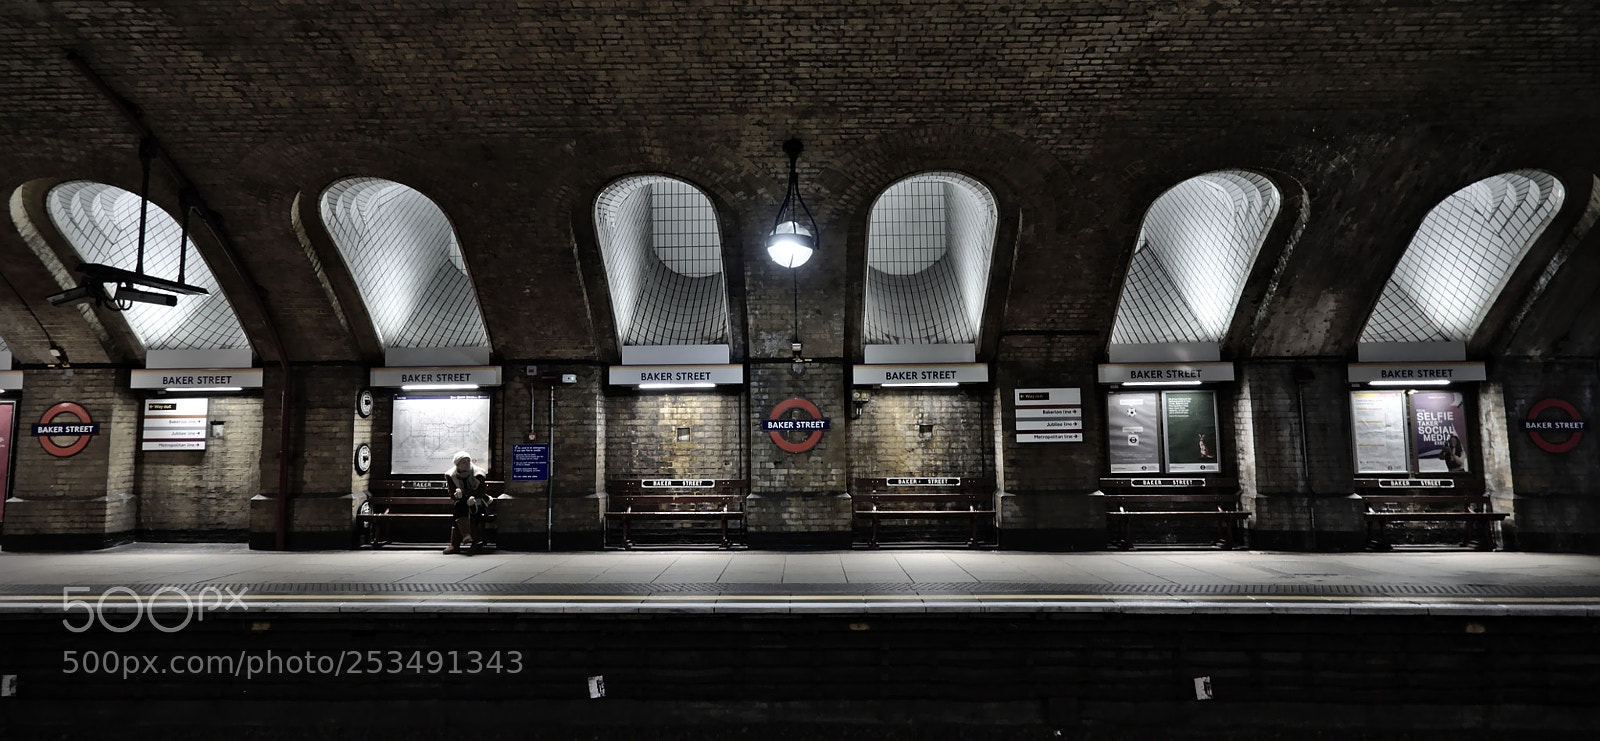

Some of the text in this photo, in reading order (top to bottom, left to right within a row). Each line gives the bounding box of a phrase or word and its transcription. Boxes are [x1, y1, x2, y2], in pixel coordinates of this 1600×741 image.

[401, 373, 471, 383] BAKER STREET
[640, 371, 712, 381] BAKER STREET
[886, 370, 957, 381] BAKER STREET
[1130, 369, 1202, 379] BAKER STREET
[1381, 368, 1453, 379] BAKER STREET
[162, 375, 232, 385] BAKER STREET
[1416, 411, 1454, 421] SELFIE
[37, 425, 94, 434] BAKER STREET
[767, 421, 826, 429] BAKER STREET
[1418, 425, 1455, 435] SOCIAL
[1525, 421, 1584, 429] BAKER STREET
[1423, 433, 1451, 442] MEDIA
